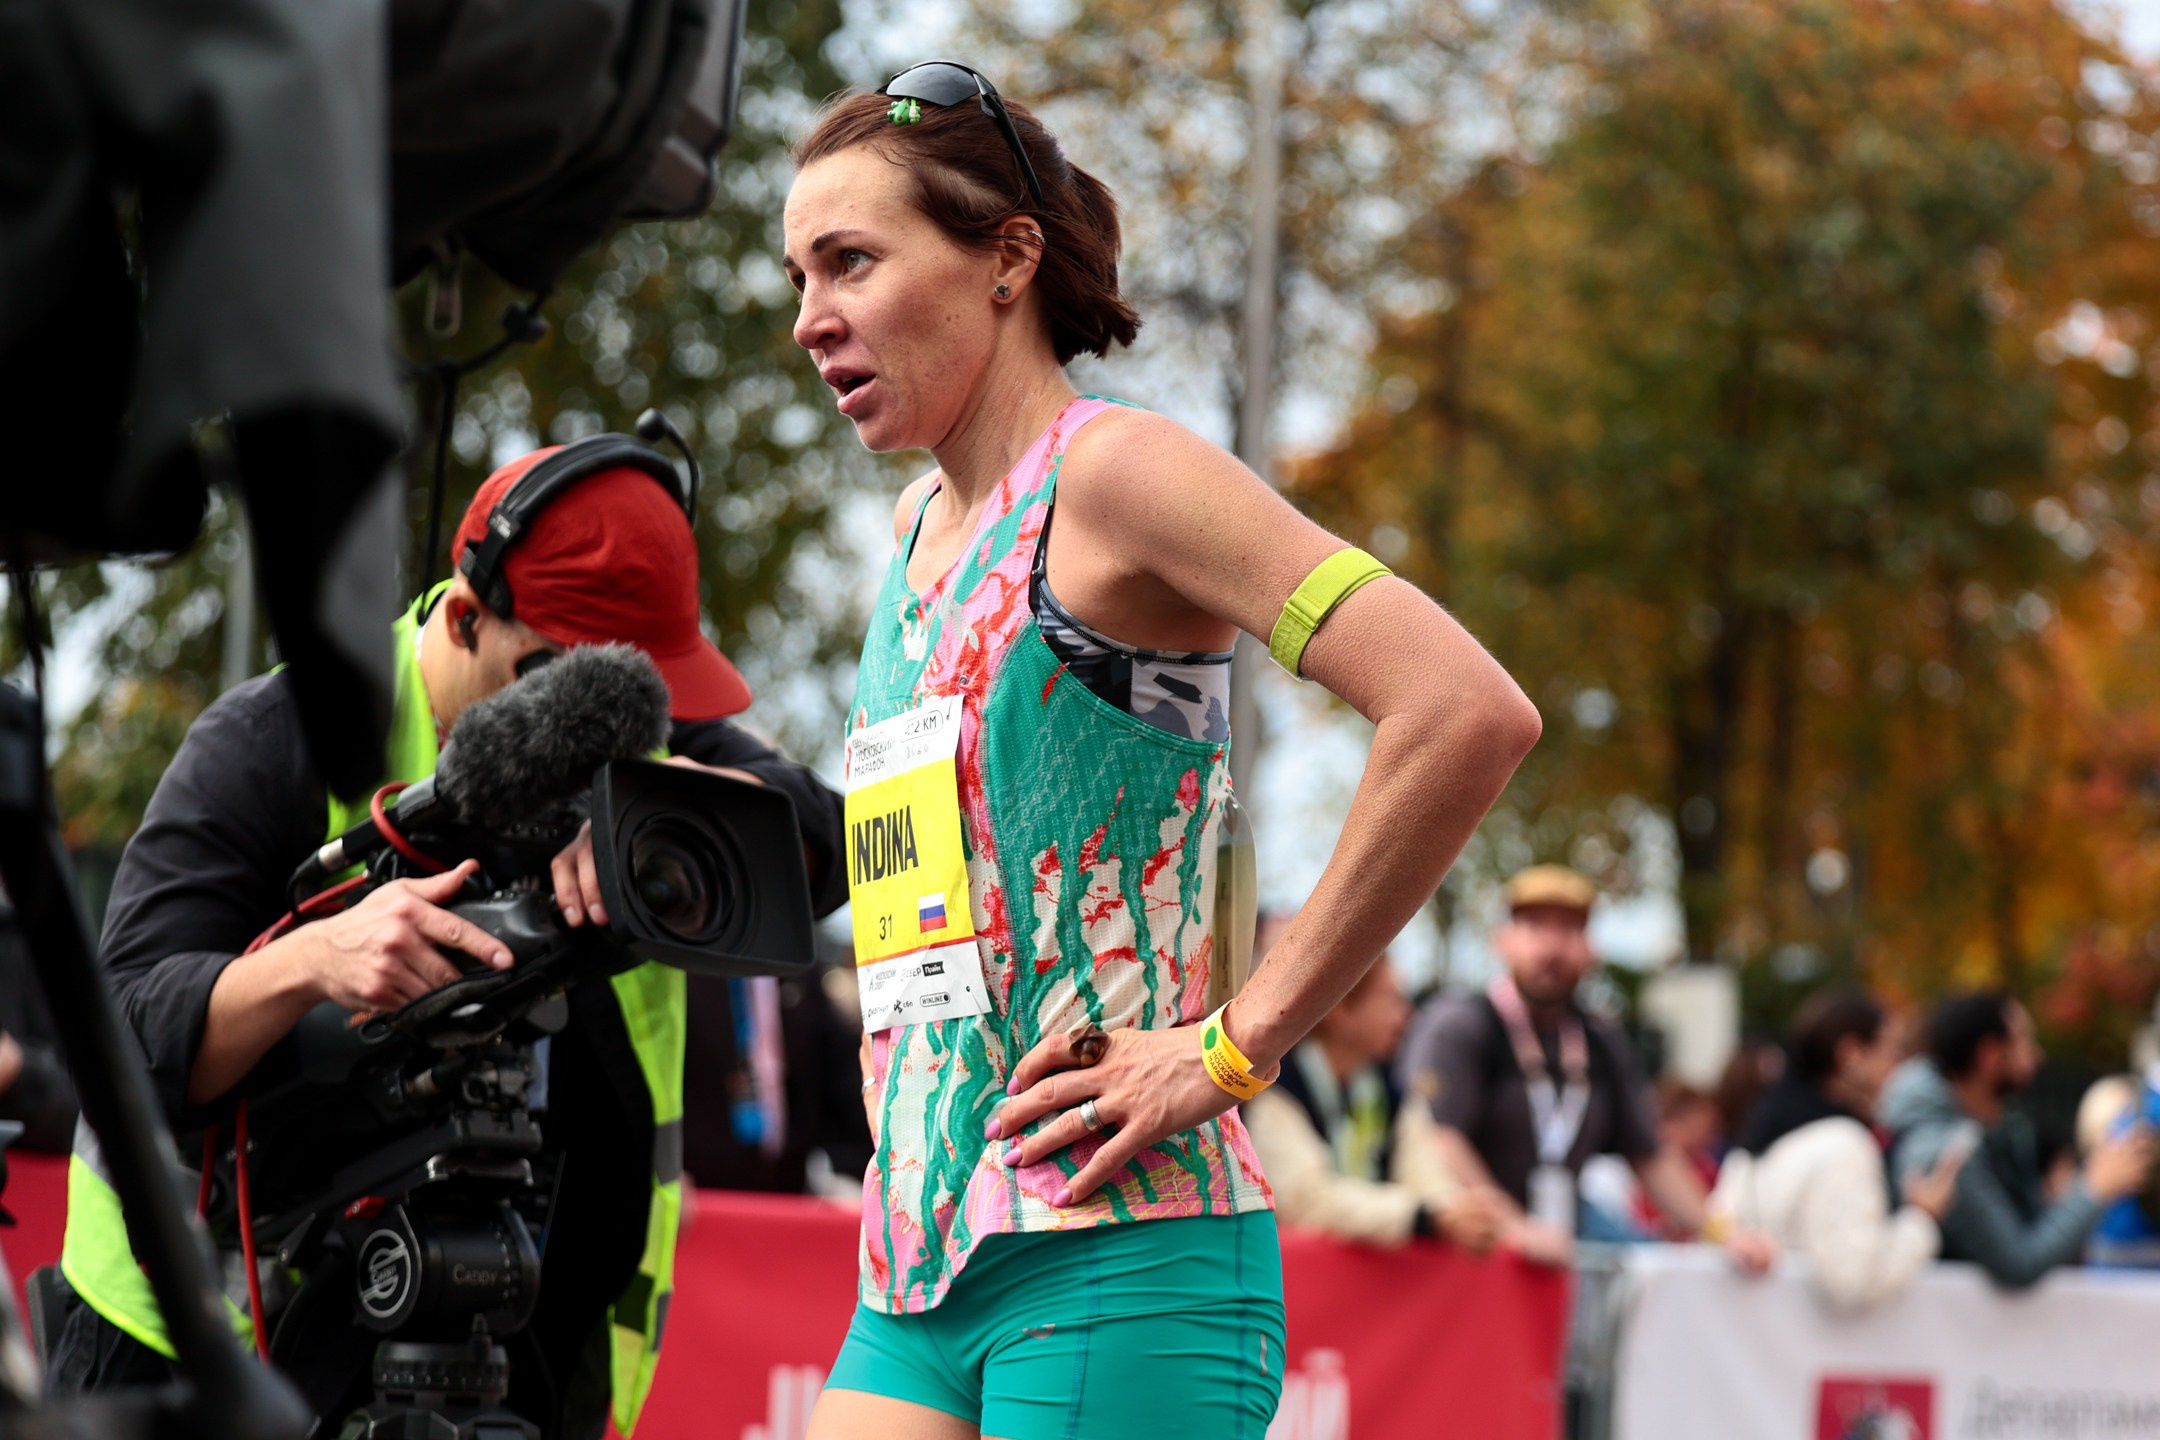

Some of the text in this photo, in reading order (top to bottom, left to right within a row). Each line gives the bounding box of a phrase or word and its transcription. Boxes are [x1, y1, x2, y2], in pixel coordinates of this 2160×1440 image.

[923, 715, 937, 731] KM
[851, 804, 919, 887] INDINA
[879, 913, 893, 941] 31
[921, 995, 943, 1005] WINLINE
[1208, 1055, 1234, 1088] МАРАФОН
[1212, 1051, 1249, 1089] МОСКОВСКИЙ
